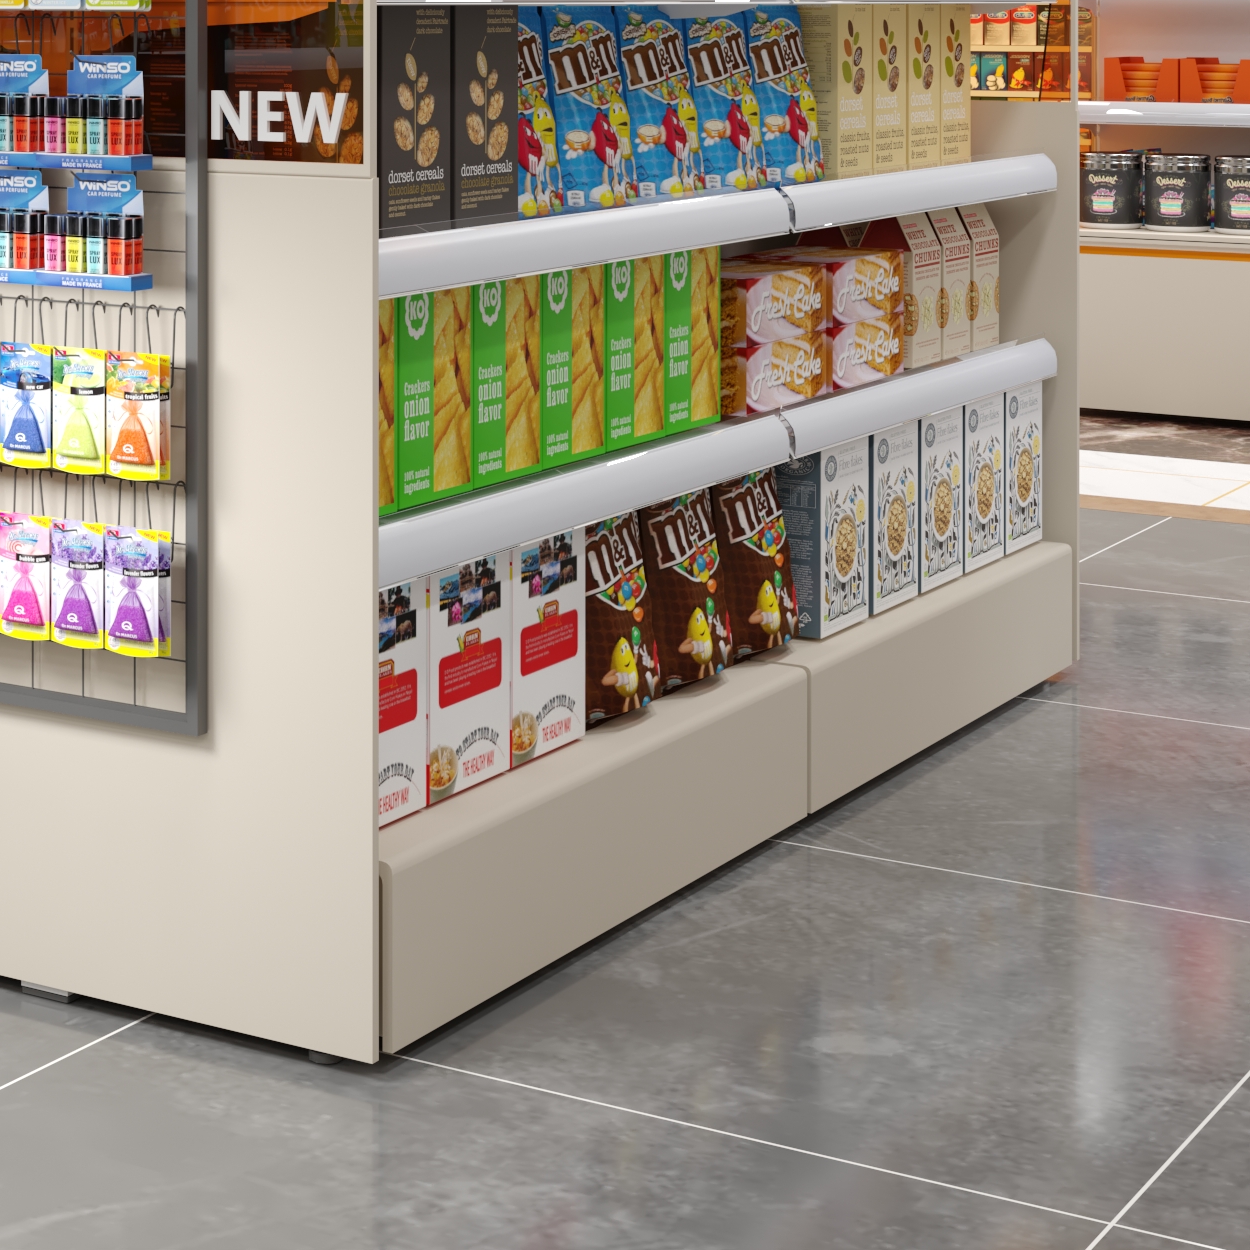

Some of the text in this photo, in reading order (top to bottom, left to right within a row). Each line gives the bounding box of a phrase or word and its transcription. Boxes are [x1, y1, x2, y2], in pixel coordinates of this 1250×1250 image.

[211, 90, 349, 144] NEW
[388, 166, 444, 184] dorset cereals
[461, 160, 513, 177] dorset cereals
[1088, 173, 1118, 184] Dessert
[1156, 176, 1186, 187] Dessert
[906, 230, 927, 240] WHITE
[937, 224, 956, 234] WHITE
[911, 239, 939, 250] CHOCOLATE
[945, 244, 970, 258] CHUNKS
[914, 250, 940, 264] CHUNKS
[836, 268, 899, 314] Fresh Cake
[410, 302, 425, 321] KO
[751, 283, 822, 334] Fresh Cake
[478, 365, 502, 380] Crackers
[404, 379, 430, 396] Crackers
[478, 379, 502, 402] onion
[404, 393, 430, 419] onion
[478, 402, 502, 424] flavor
[404, 418, 430, 442] flavor
